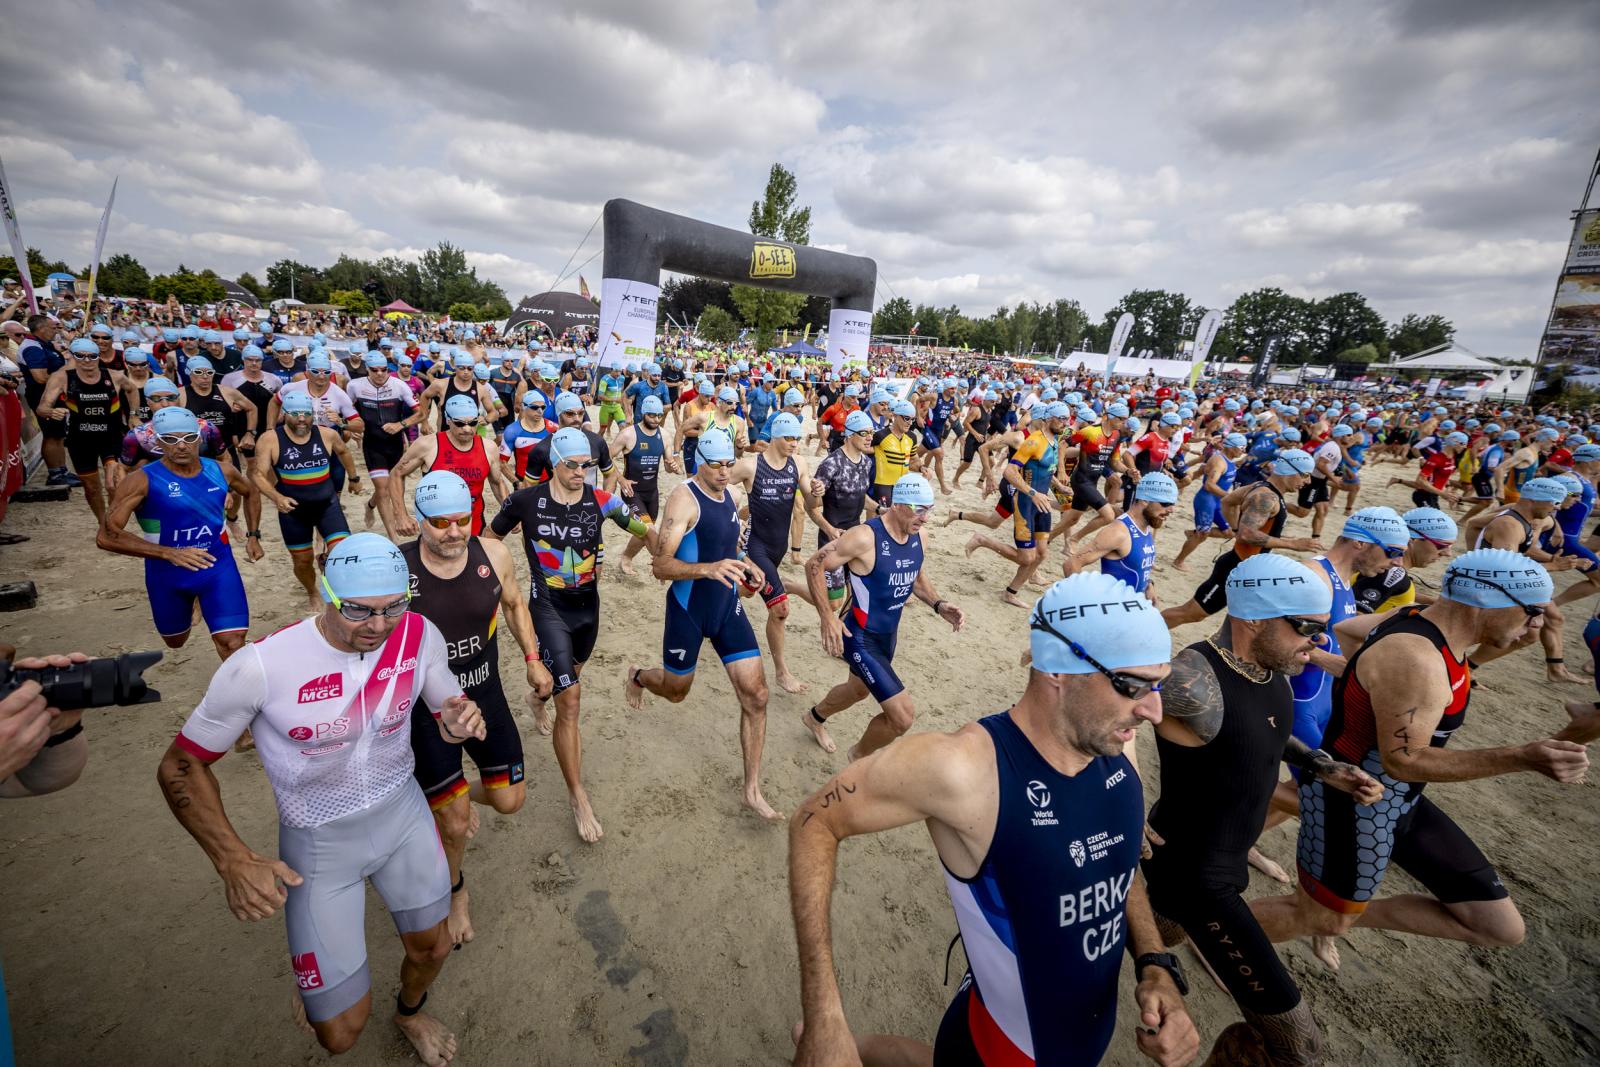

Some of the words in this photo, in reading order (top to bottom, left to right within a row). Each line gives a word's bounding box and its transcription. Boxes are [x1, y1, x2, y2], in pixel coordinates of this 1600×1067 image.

[622, 294, 657, 307] XTERR
[520, 307, 555, 315] XTERRA
[844, 320, 871, 328] XTERR
[1259, 338, 1277, 375] XTERRA
[84, 407, 105, 415] GER
[283, 458, 329, 470] MACH3
[1404, 516, 1445, 525] TERRA
[173, 525, 213, 541] ITA
[537, 522, 582, 540] elys
[326, 555, 359, 566] RRA
[1447, 566, 1538, 578] XTERRA
[1227, 576, 1305, 588] XTERRA
[893, 585, 911, 598] CZE
[1033, 600, 1144, 624] XTERRA
[447, 635, 482, 660] GER
[301, 687, 340, 702] MGC
[1105, 768, 1127, 789] ATEX
[1034, 810, 1054, 818] World
[1031, 818, 1059, 826] Triathlon
[1086, 831, 1108, 845] CZECH
[1088, 834, 1125, 853] TRIATHLON
[1090, 850, 1108, 861] TEAM
[1082, 911, 1123, 961] CZE
[1207, 922, 1264, 991] RYZON
[298, 974, 320, 988] GC
